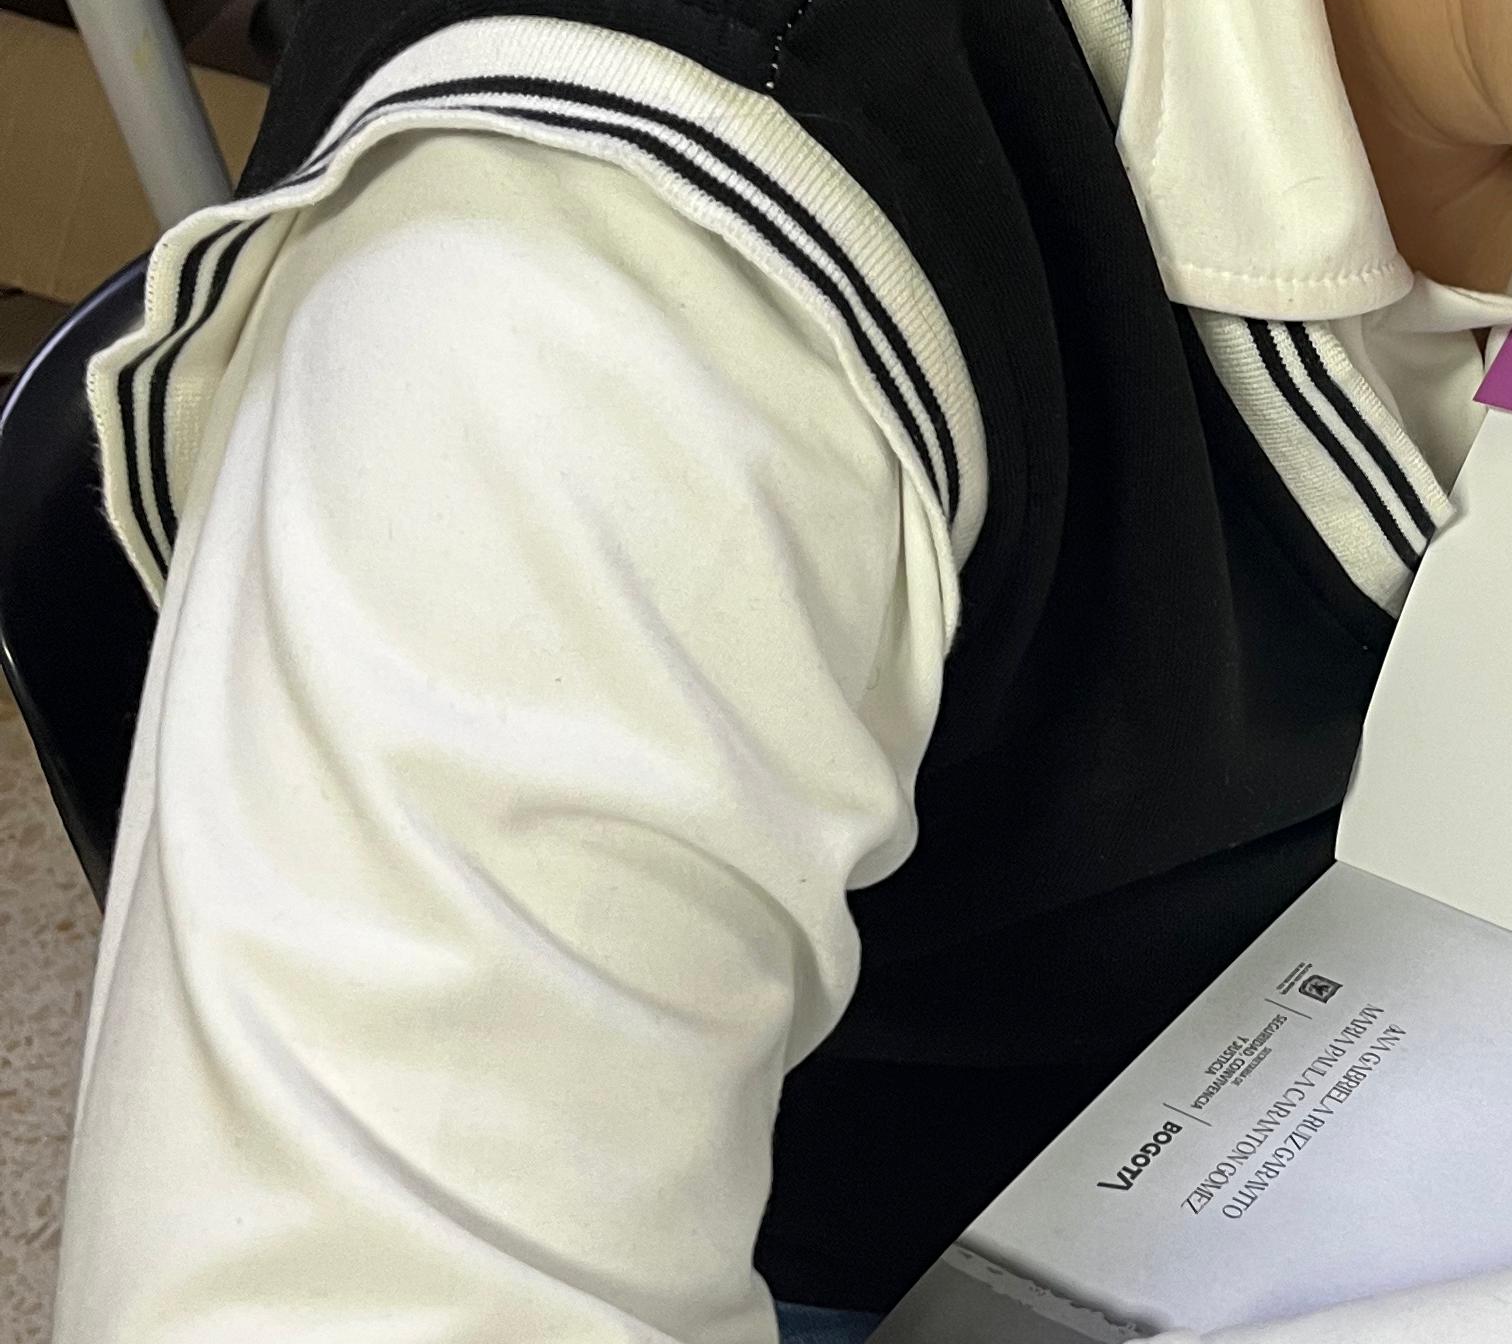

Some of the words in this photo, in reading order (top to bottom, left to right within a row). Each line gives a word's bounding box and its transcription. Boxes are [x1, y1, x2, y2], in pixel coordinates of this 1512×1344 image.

[1236, 1035, 1250, 1044] Y
[1370, 1024, 1406, 1051] ANA
[1204, 1041, 1243, 1075] JUSTICIA
[1294, 1044, 1346, 1088] PAULA
[1191, 1058, 1245, 1109] CONVIVENCIA
[1313, 1052, 1381, 1114] GABRIELA
[1283, 1114, 1325, 1151] RUIZ
[1222, 1147, 1295, 1219] GARAVITO
